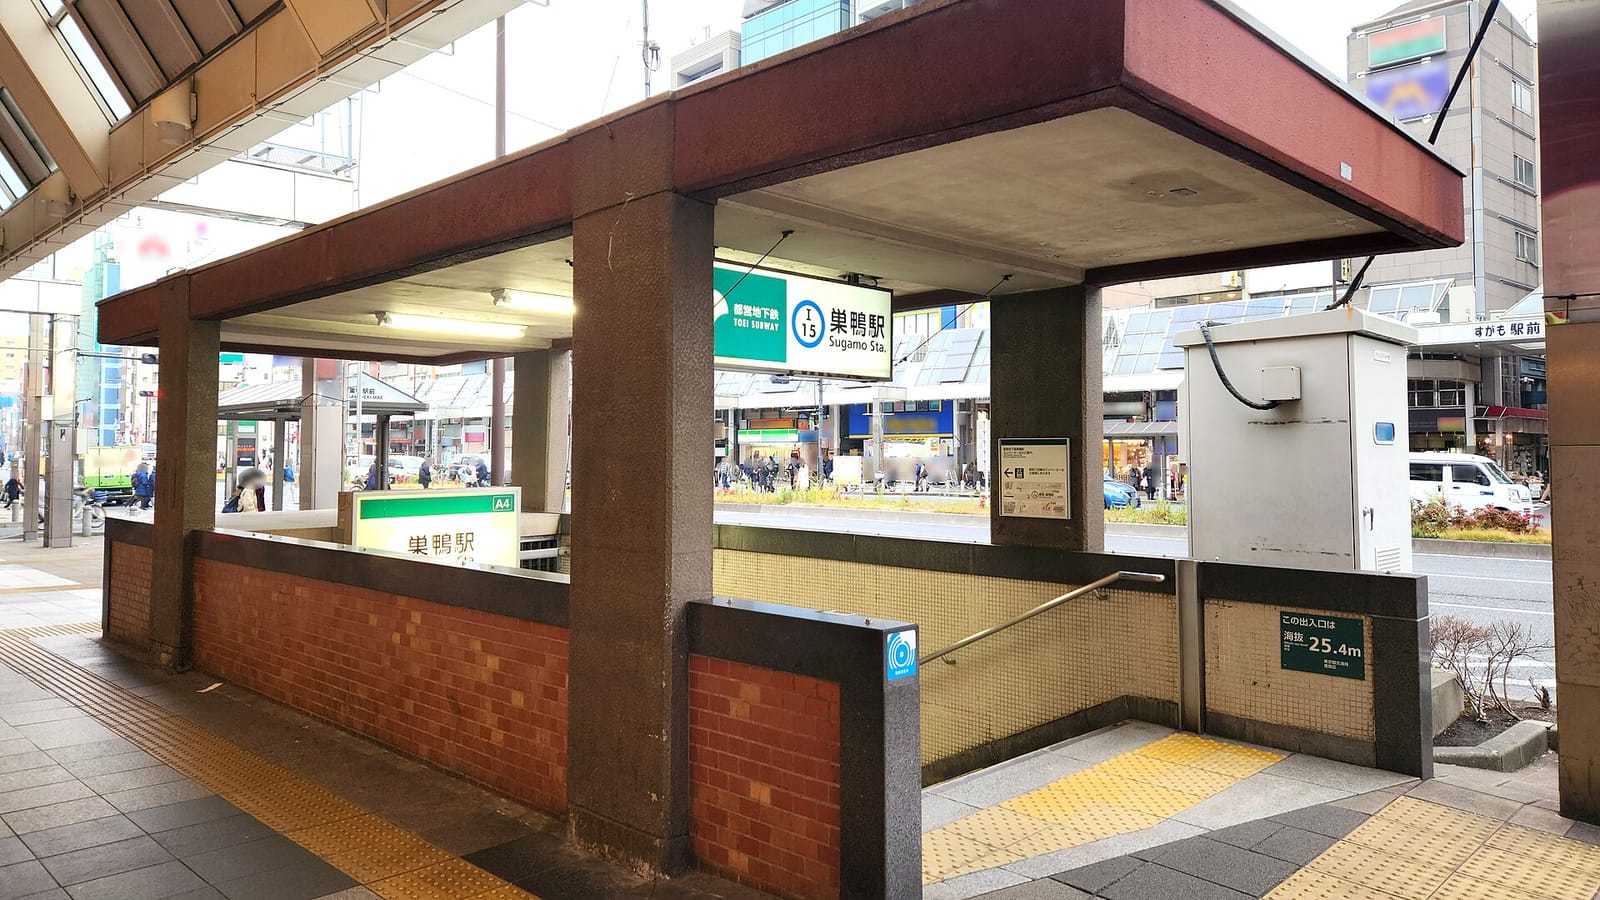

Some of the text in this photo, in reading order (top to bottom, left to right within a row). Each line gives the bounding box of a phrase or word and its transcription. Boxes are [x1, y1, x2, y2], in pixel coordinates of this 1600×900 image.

[733, 303, 779, 321] 都営地下鉄
[806, 308, 812, 321] I
[733, 318, 779, 332] TOEI SUBWAY
[801, 323, 816, 338] 15
[830, 307, 885, 339] 巣鴨駅
[829, 335, 887, 353] Sugamo Sta.
[495, 497, 510, 509] A4
[408, 532, 474, 555] 巣鴨駅
[1282, 615, 1336, 630] この出入口は
[1283, 630, 1304, 642] 海抜
[1309, 636, 1361, 657] 25.4m
